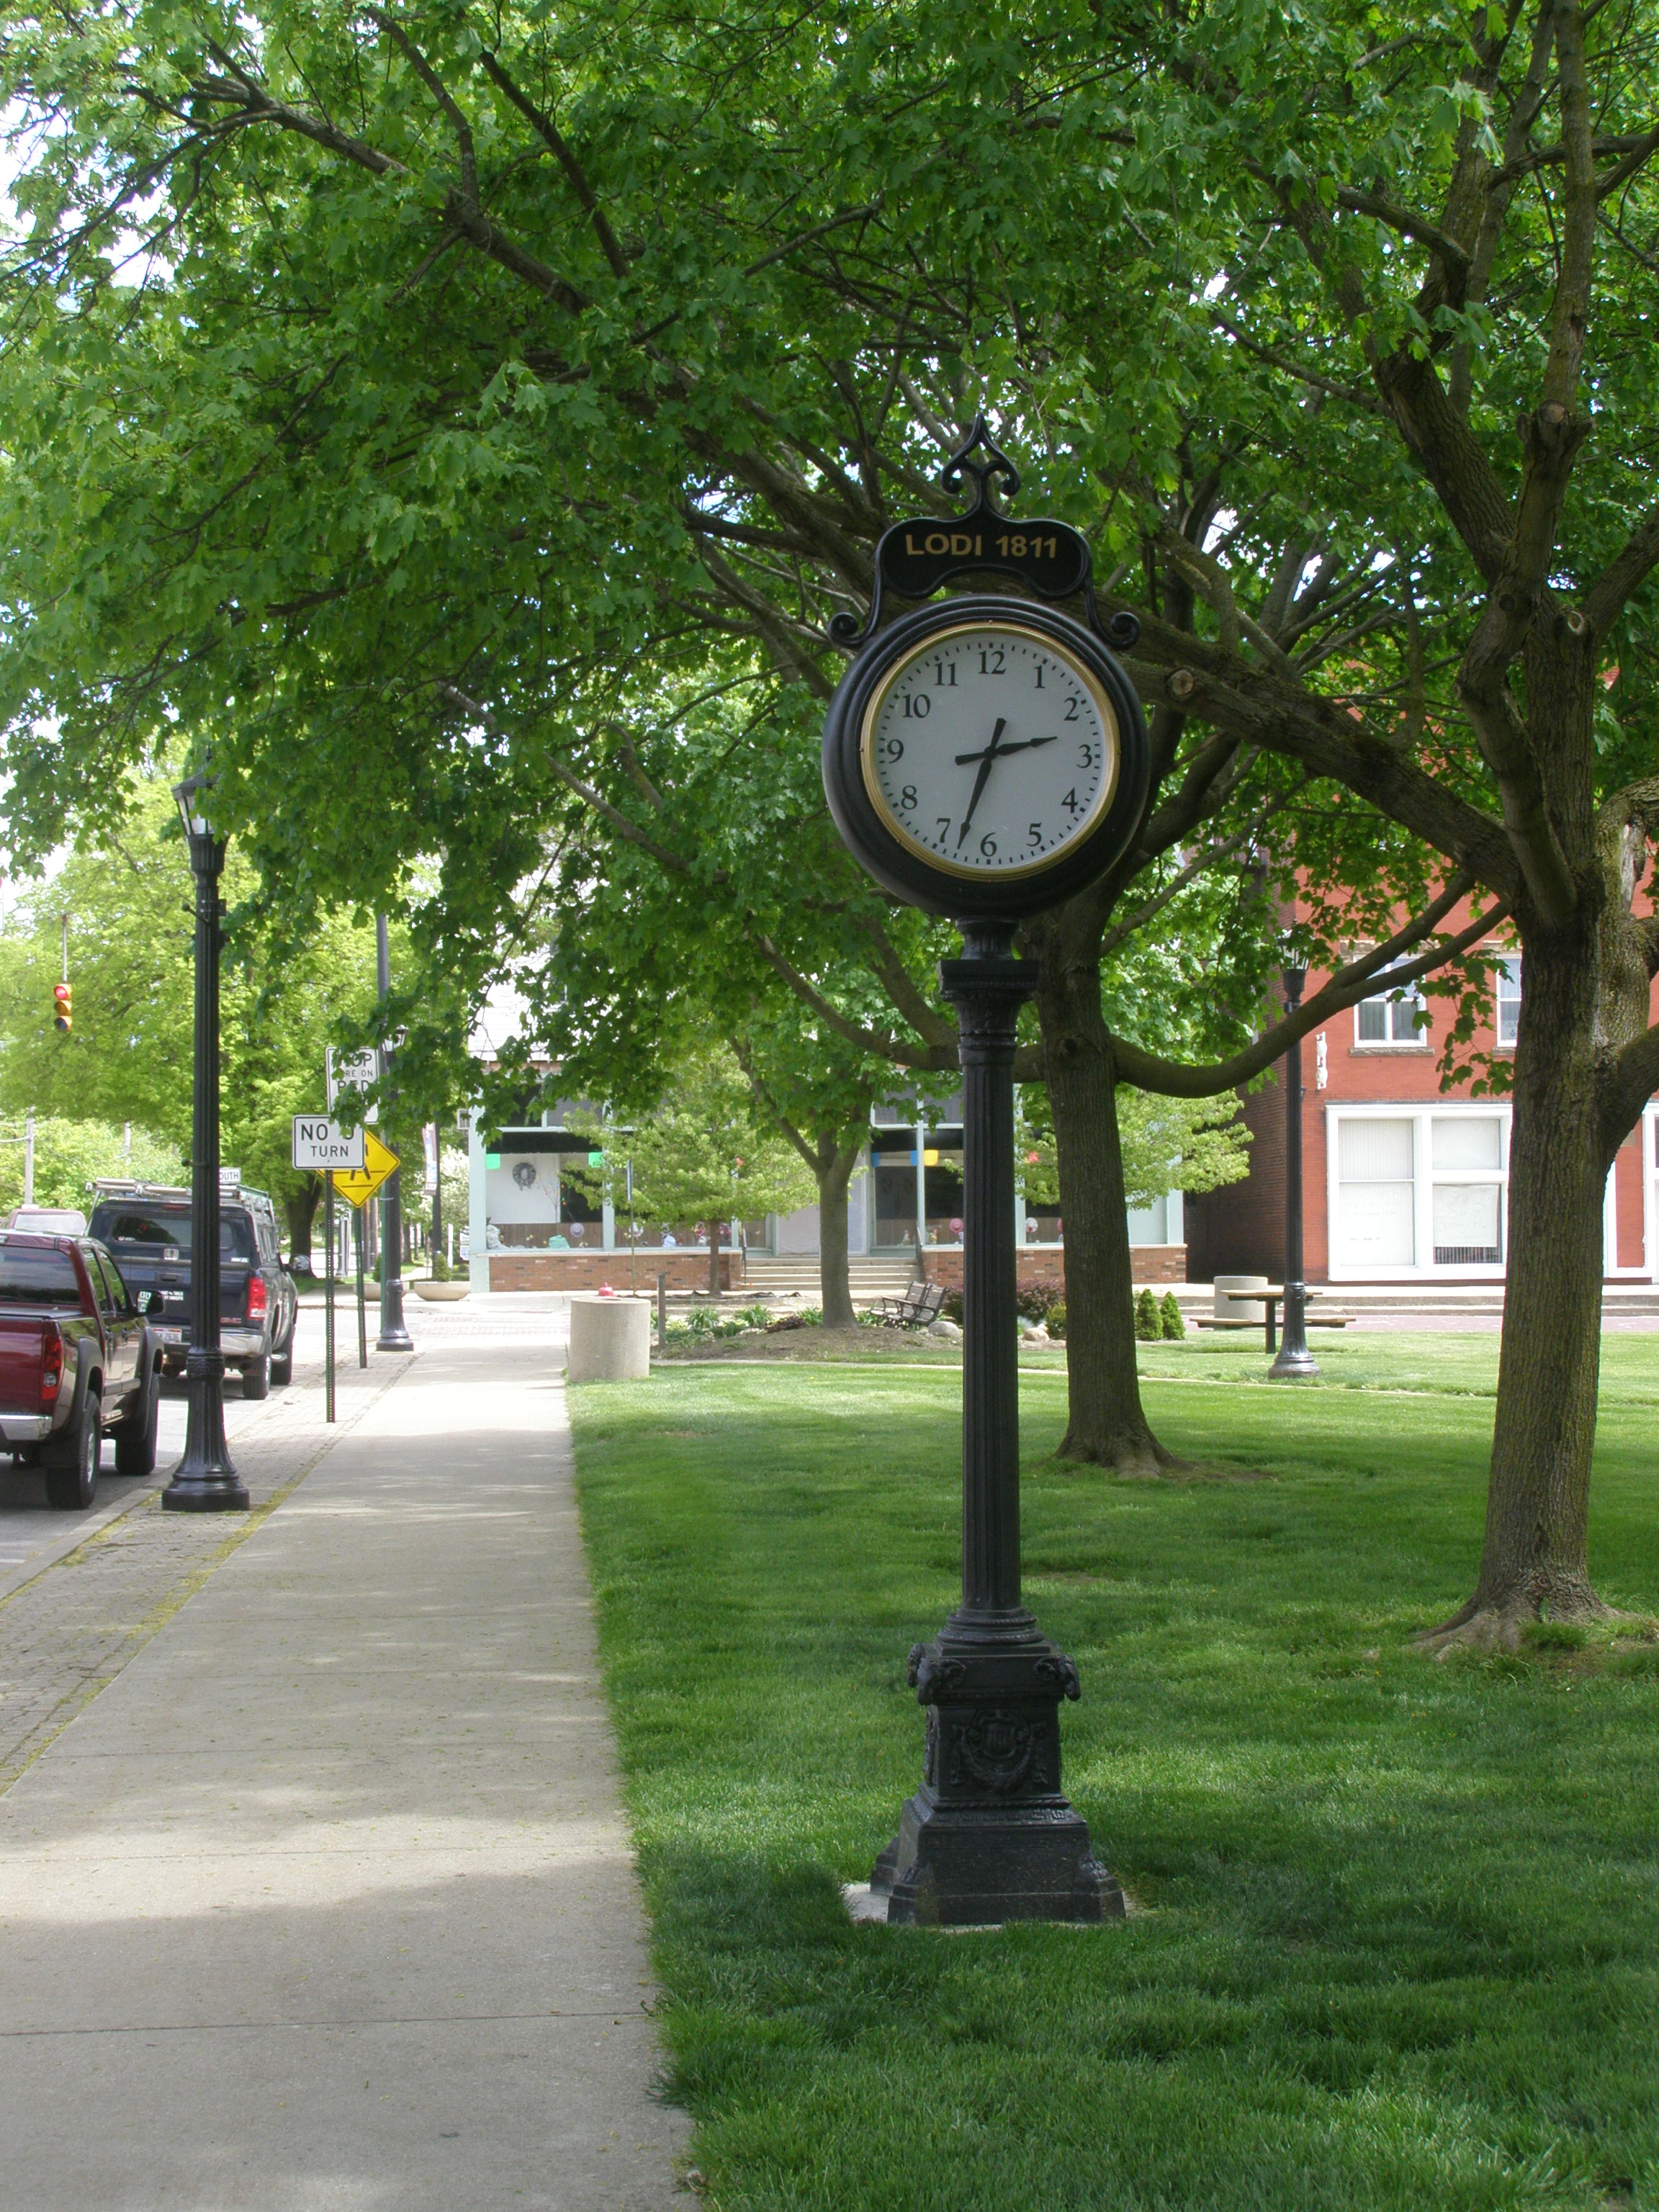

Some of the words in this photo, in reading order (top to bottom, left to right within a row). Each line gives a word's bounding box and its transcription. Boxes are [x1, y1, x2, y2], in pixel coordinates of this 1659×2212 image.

[906, 534, 982, 556] LODI
[996, 536, 1057, 559] 1811
[935, 662, 958, 686] 11
[979, 650, 1007, 674] 12
[1034, 665, 1046, 688] 1
[902, 693, 931, 719] 10
[1064, 697, 1079, 721] 2
[886, 739, 904, 764] 9
[1076, 744, 1092, 768] 3
[901, 785, 917, 810] 8
[1061, 787, 1079, 814] 4
[936, 817, 951, 843] 7
[1027, 822, 1042, 847] 5
[980, 832, 997, 857] 6
[301, 1123, 328, 1141] NO
[310, 1146, 349, 1157] TURN
